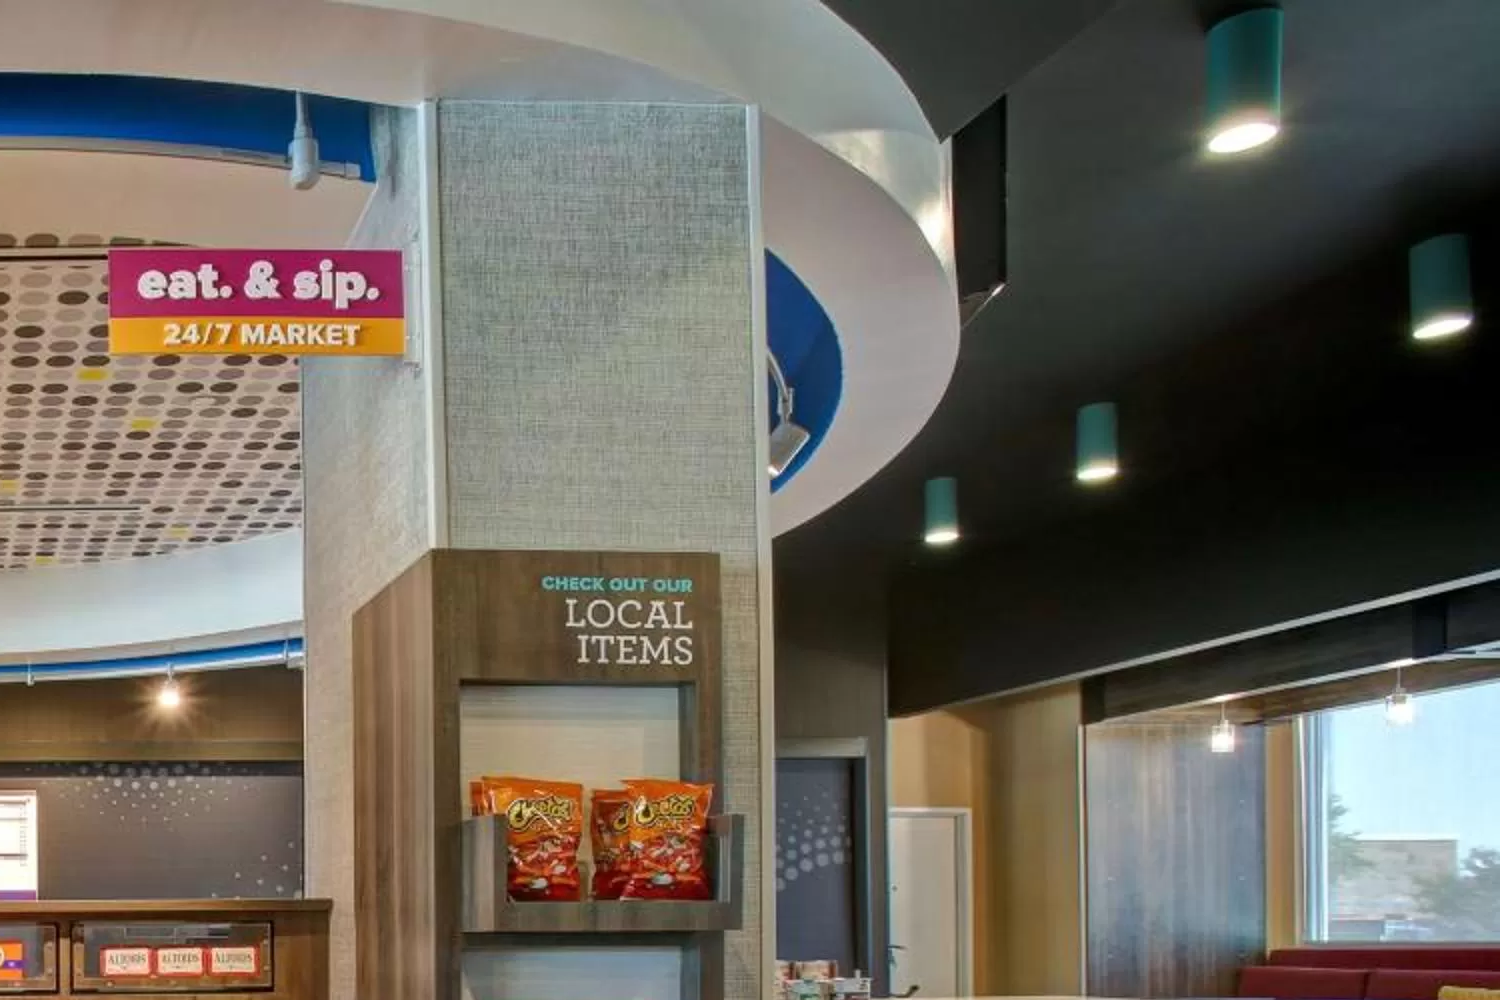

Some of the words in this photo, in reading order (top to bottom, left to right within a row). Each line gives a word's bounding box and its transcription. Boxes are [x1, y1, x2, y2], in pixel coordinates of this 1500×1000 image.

[138, 264, 233, 299] eat.
[244, 260, 281, 299] &
[293, 258, 380, 309] sip.
[164, 323, 231, 345] 24/7
[240, 324, 360, 346] MARKET
[542, 576, 604, 591] CHECK
[609, 578, 648, 591] OUT
[652, 579, 693, 593] OUR
[565, 598, 693, 629] LOCAL
[577, 635, 693, 665] ITEMS
